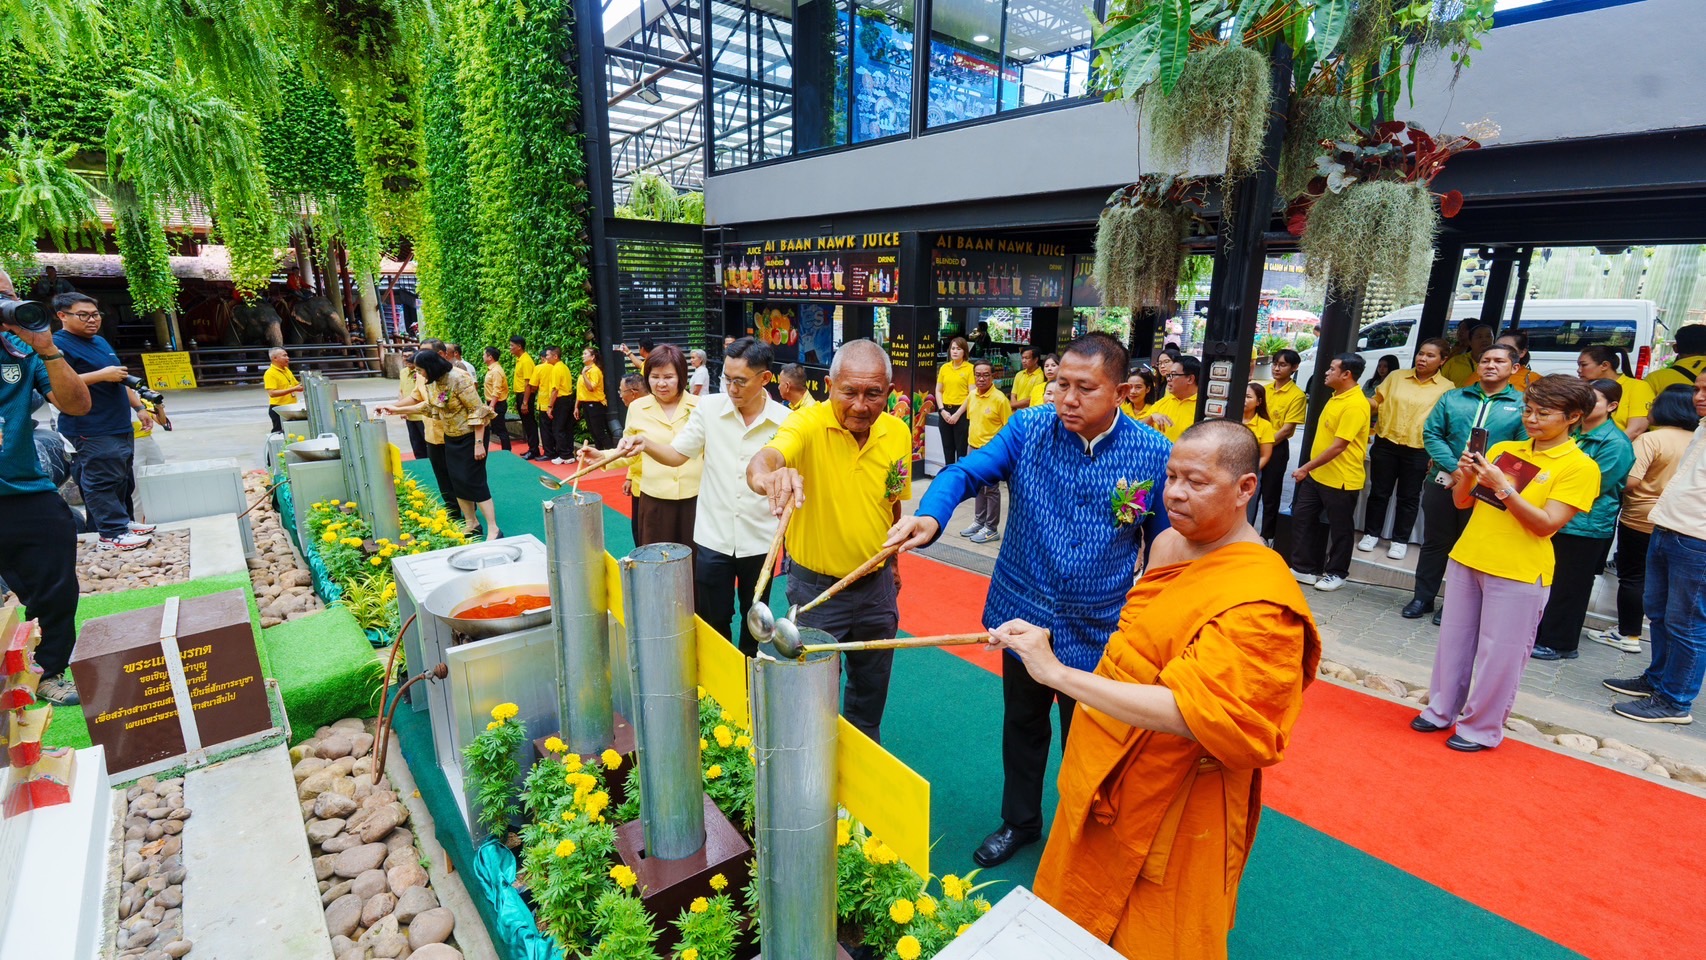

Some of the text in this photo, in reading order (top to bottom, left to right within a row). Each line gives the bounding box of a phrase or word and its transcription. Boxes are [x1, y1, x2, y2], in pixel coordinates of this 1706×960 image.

[764, 231, 900, 252] AI BAAN NAWK JUICE
[937, 234, 1066, 257] AI BAAN NAWK JUICE
[746, 247, 762, 255] JUICE
[935, 257, 960, 266] BLENDED
[891, 350, 909, 358] NAWK
[892, 359, 908, 367] JUICE
